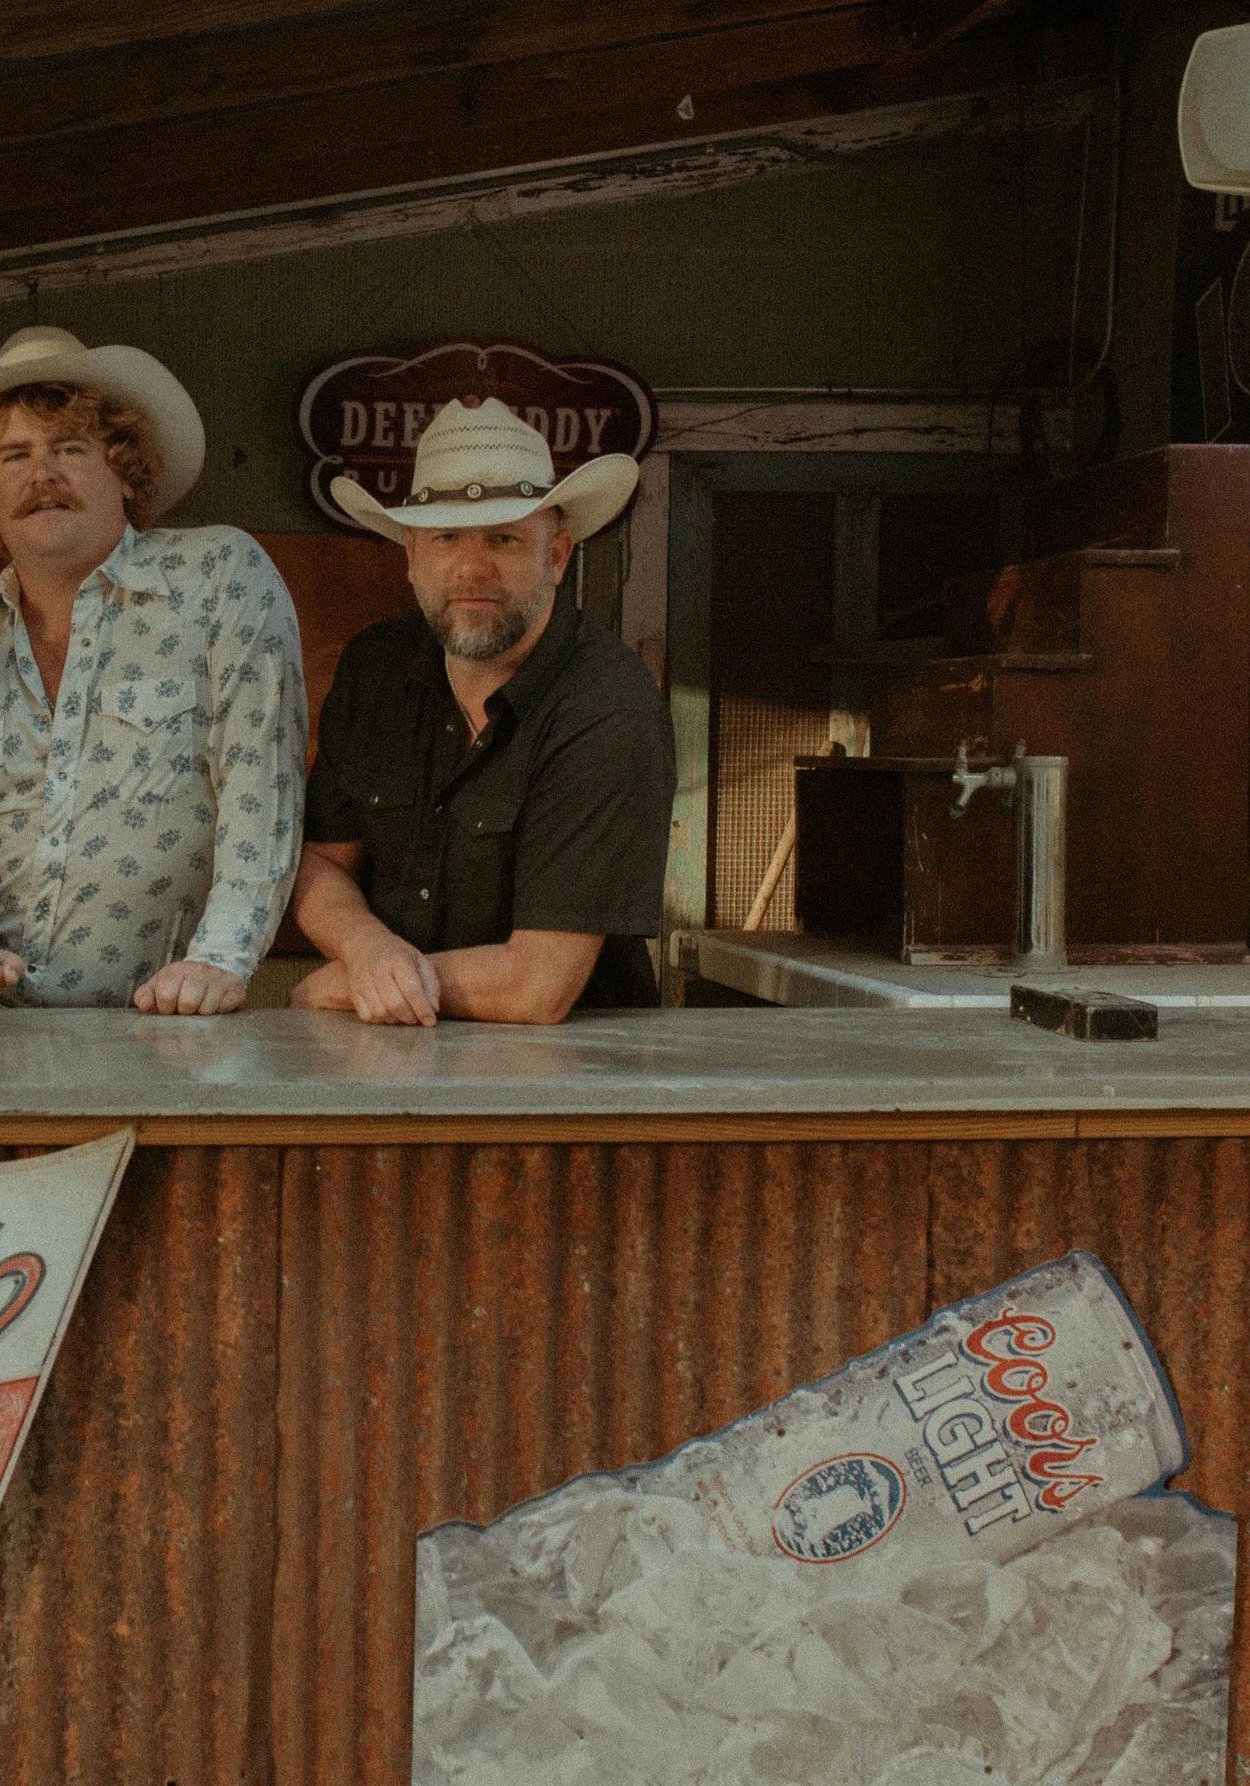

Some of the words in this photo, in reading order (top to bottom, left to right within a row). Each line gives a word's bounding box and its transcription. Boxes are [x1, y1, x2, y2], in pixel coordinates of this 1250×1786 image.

[340, 400, 447, 450] DEE
[515, 405, 612, 455] DDY
[893, 1349, 1033, 1537] LIGHT
[904, 1447, 934, 1489] BEER
[960, 1307, 1104, 1513] Coors
